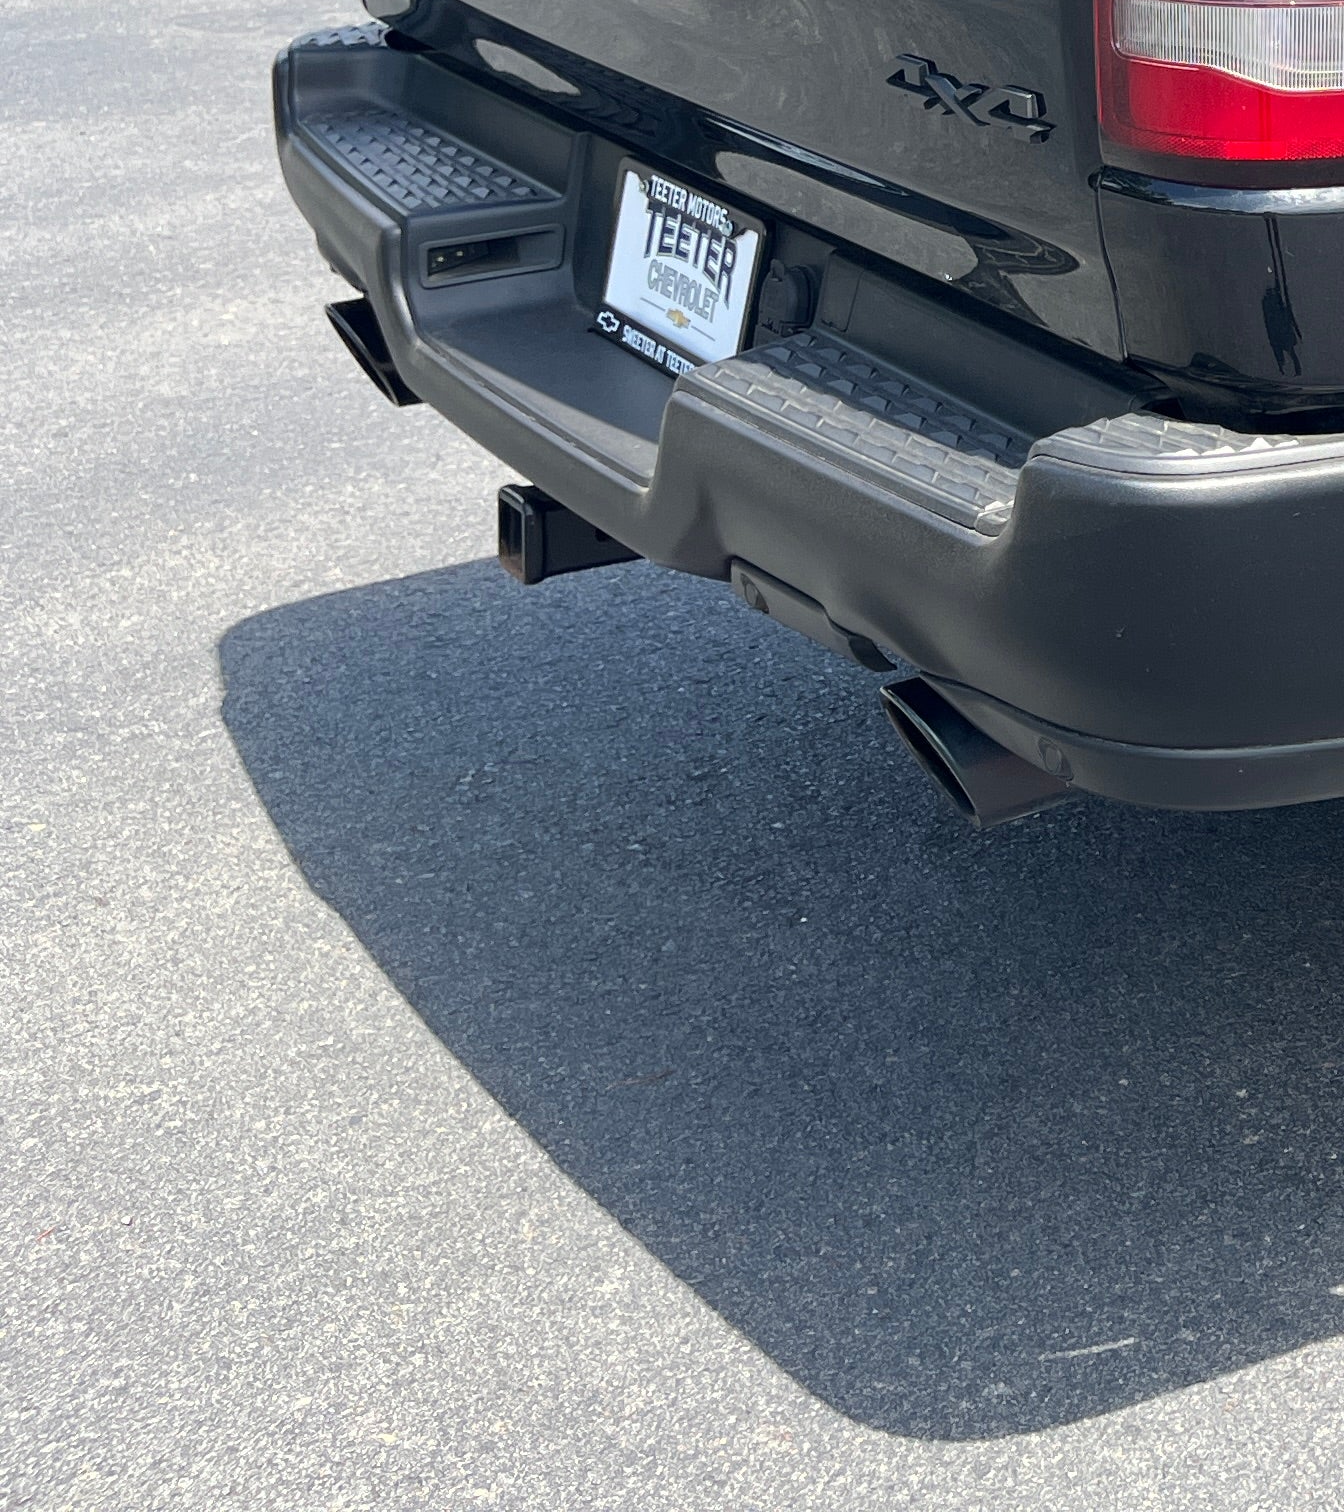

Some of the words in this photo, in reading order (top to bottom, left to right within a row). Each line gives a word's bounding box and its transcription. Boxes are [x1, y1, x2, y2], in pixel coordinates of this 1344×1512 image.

[650, 174, 688, 212] TEETER
[686, 191, 730, 231] MOTORS
[643, 205, 737, 310] TEETER
[647, 258, 720, 324] CHEVROLET
